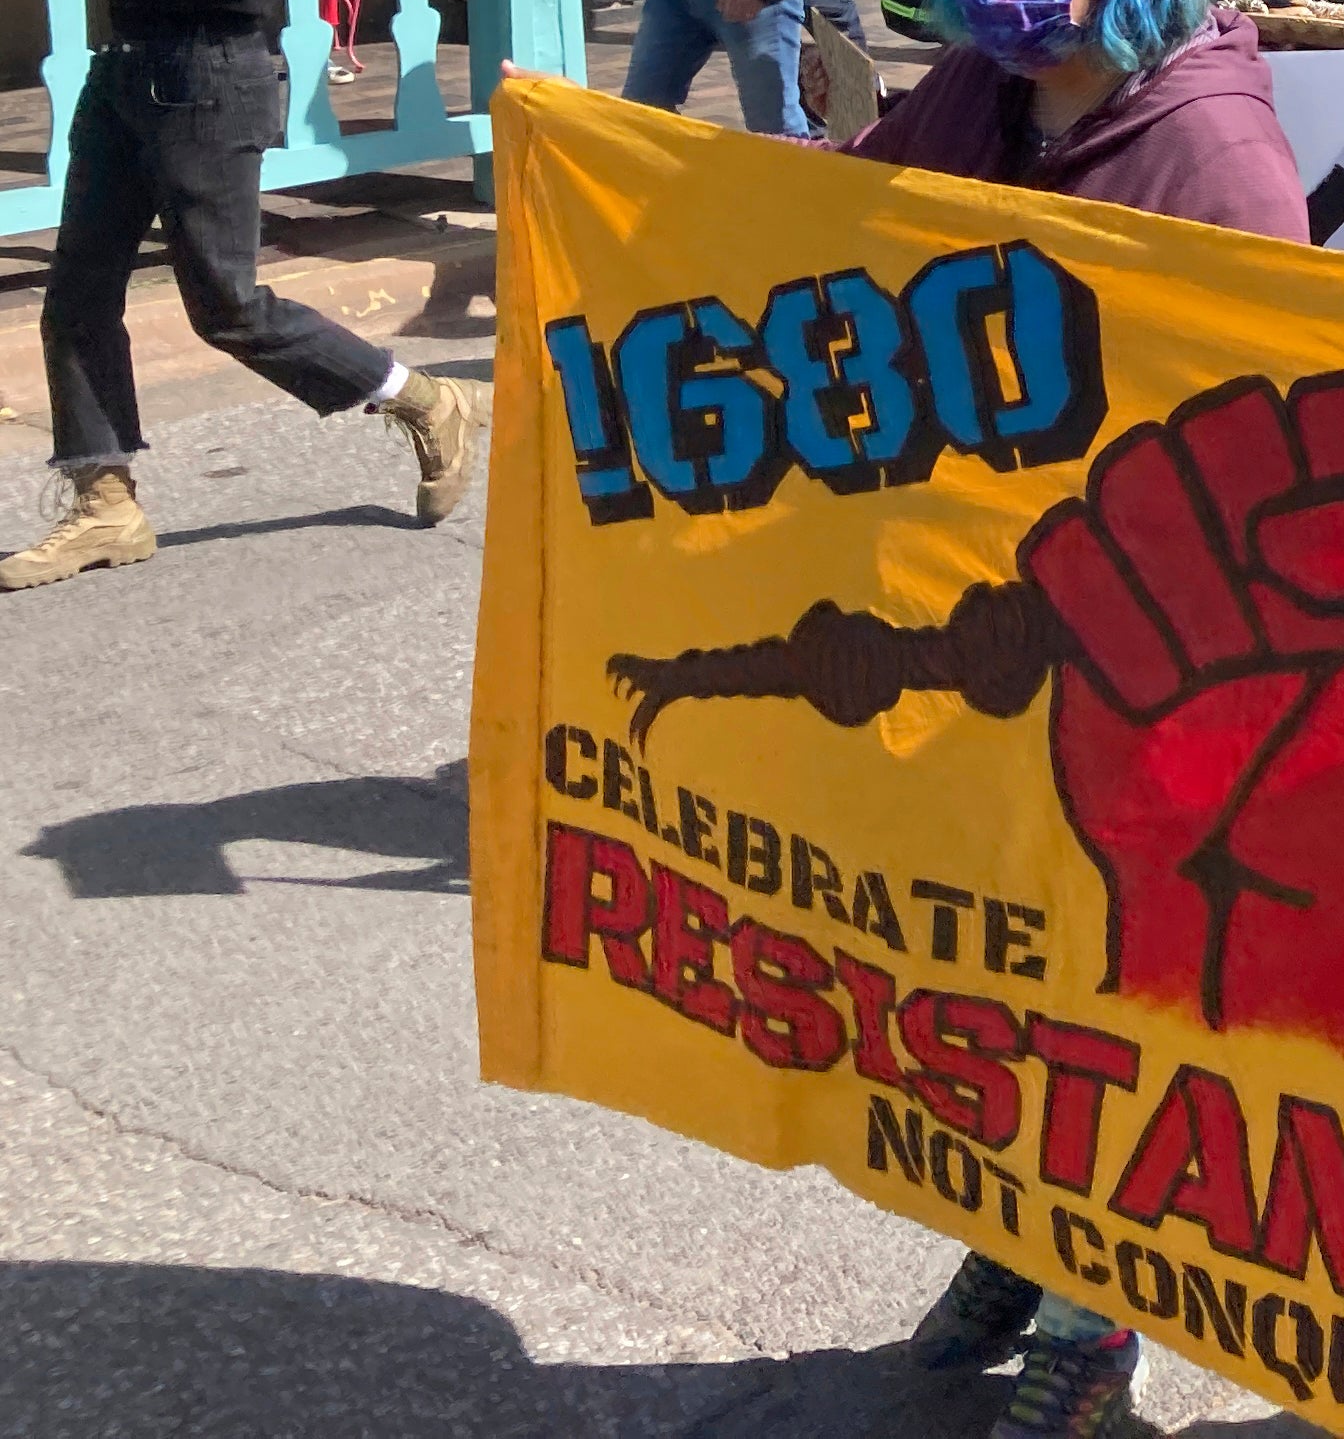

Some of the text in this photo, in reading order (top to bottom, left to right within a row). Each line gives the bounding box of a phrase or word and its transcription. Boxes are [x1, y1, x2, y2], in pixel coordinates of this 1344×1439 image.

[545, 238, 1109, 528] 1680
[544, 723, 1048, 981] CELEBRATE
[867, 1094, 1026, 1237] NOT
